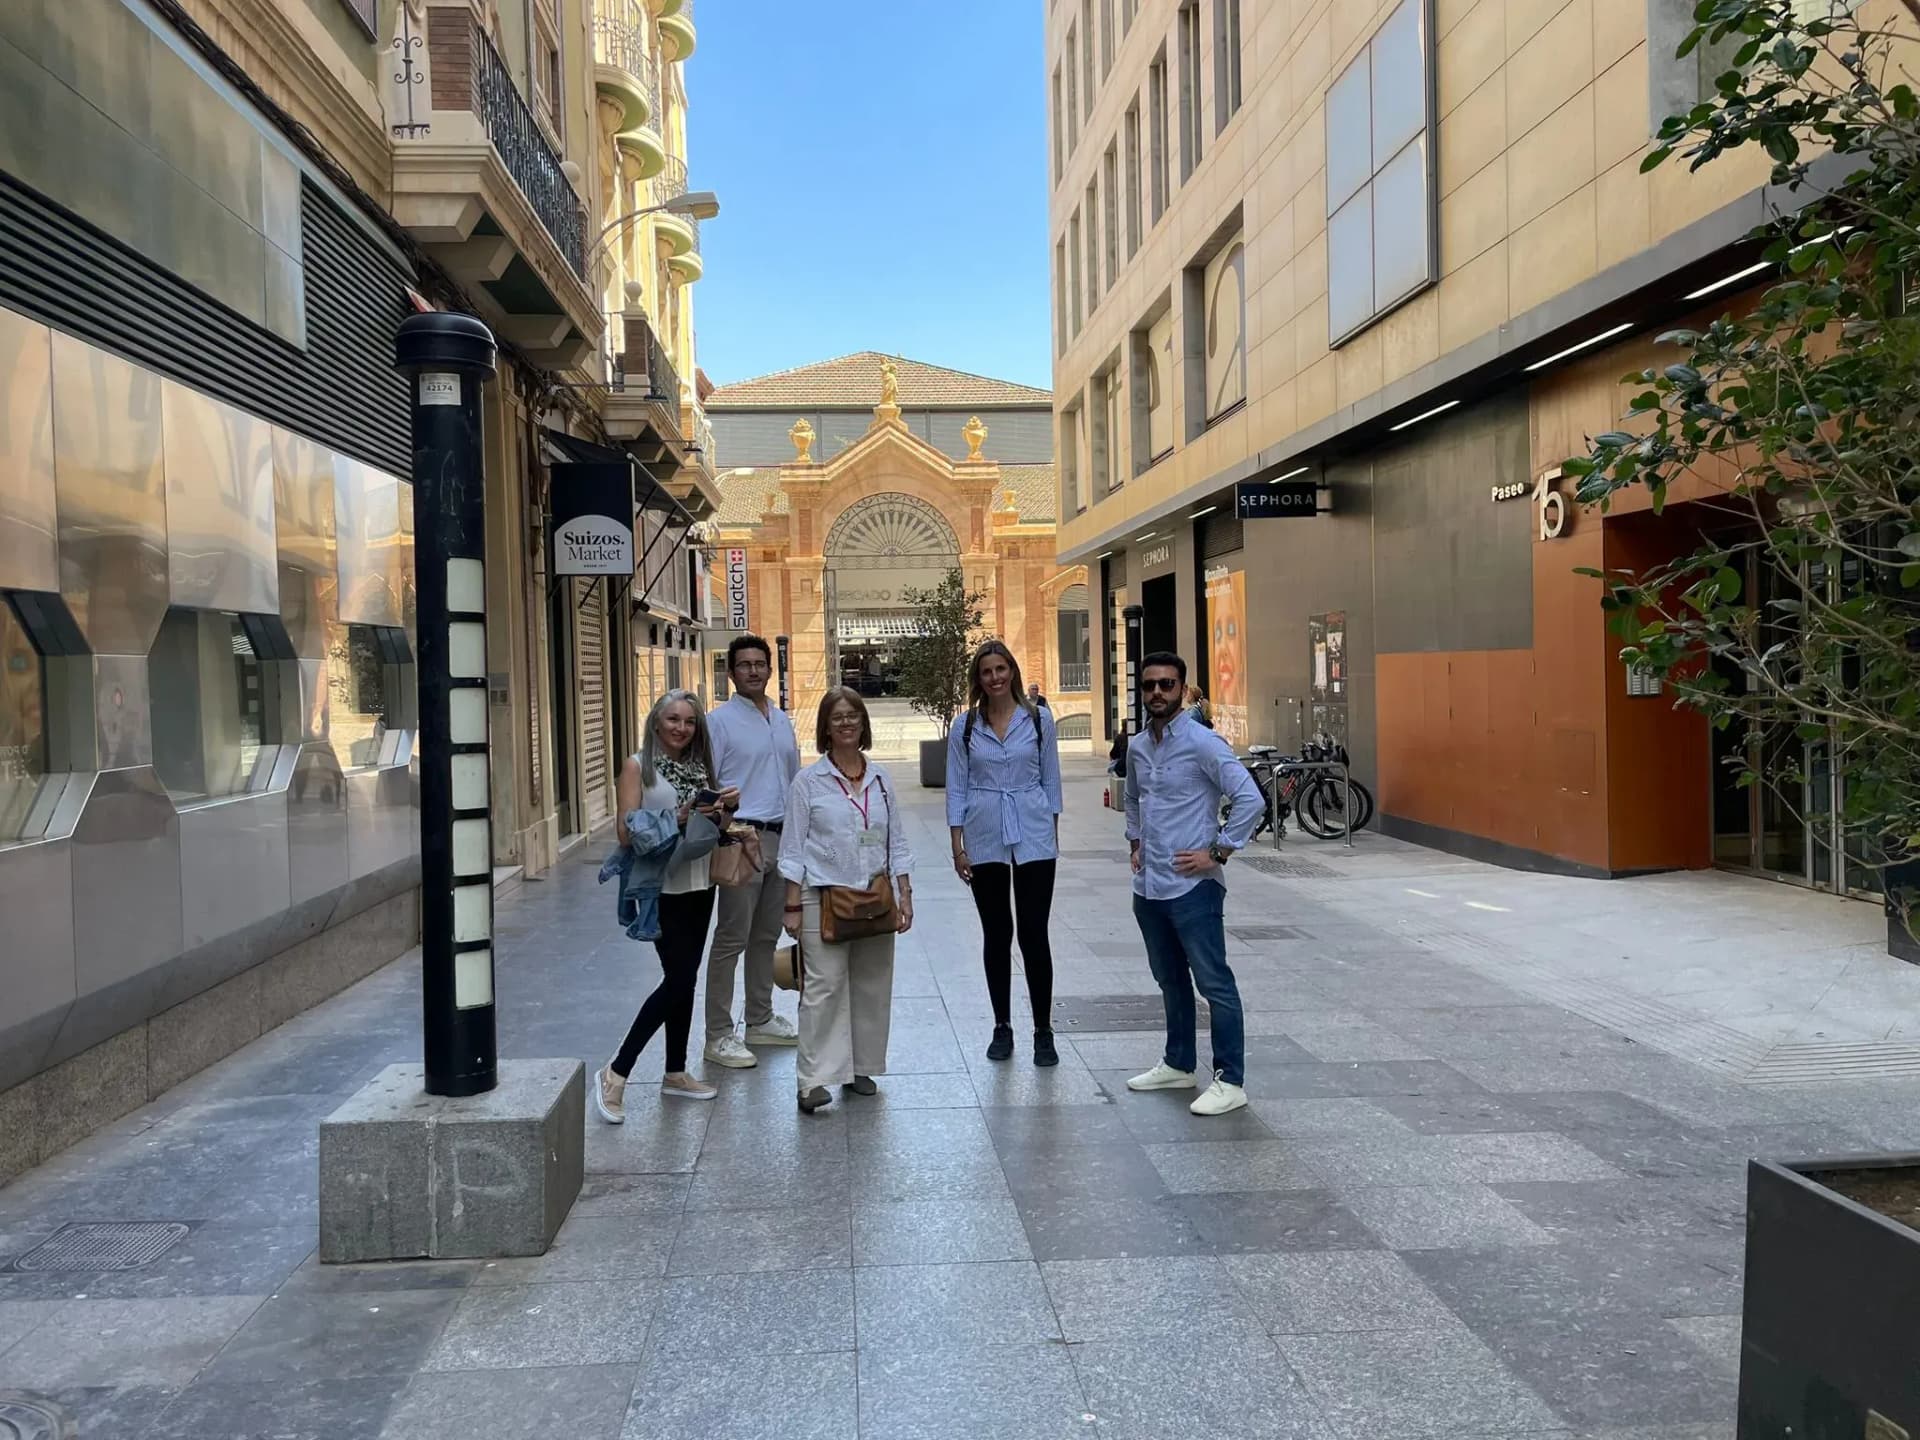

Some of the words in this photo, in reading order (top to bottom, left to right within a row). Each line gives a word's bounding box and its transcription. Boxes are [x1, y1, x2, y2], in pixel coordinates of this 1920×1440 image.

[1240, 494, 1314, 506] SEPHORA
[1491, 484, 1525, 501] Paseo
[1532, 468, 1564, 541] 15
[563, 531, 625, 546] Suizos.
[568, 547, 622, 561] Market
[1143, 545, 1169, 567] SEPHORA
[729, 562, 746, 628] swatch
